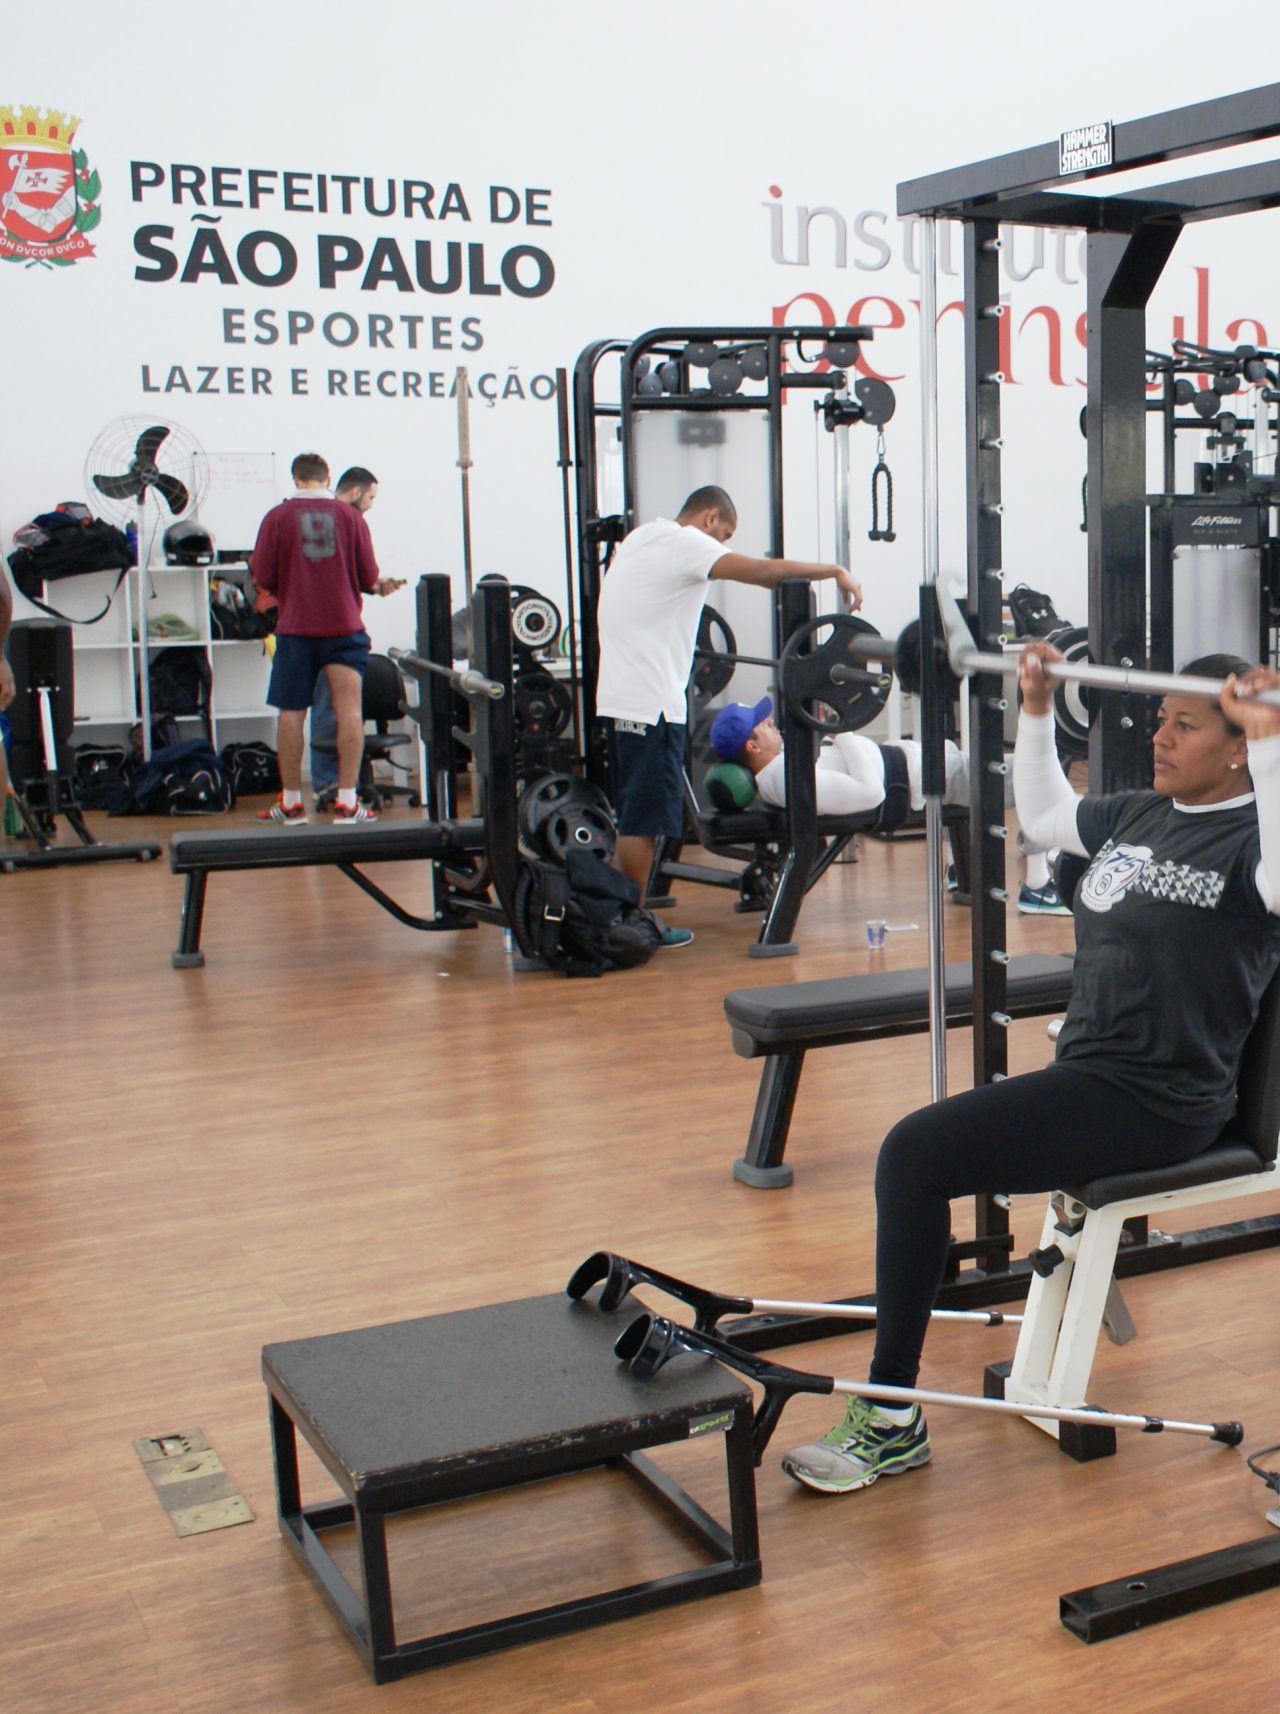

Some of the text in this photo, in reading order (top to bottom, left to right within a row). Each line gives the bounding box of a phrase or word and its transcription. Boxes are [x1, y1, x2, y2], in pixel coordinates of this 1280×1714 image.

[1062, 143, 1109, 172] STRENGTH
[1063, 124, 1107, 153] HAMMER
[130, 160, 553, 227] PREFEITURA DE
[0, 237, 15, 250] ON
[132, 213, 556, 299] SÃO PAULO
[761, 184, 1088, 285] instiut
[222, 307, 485, 352] ESPORTES
[771, 267, 1268, 405] peínla
[140, 364, 558, 409] LAZER E RECREAÇÃO
[300, 510, 337, 561] 9
